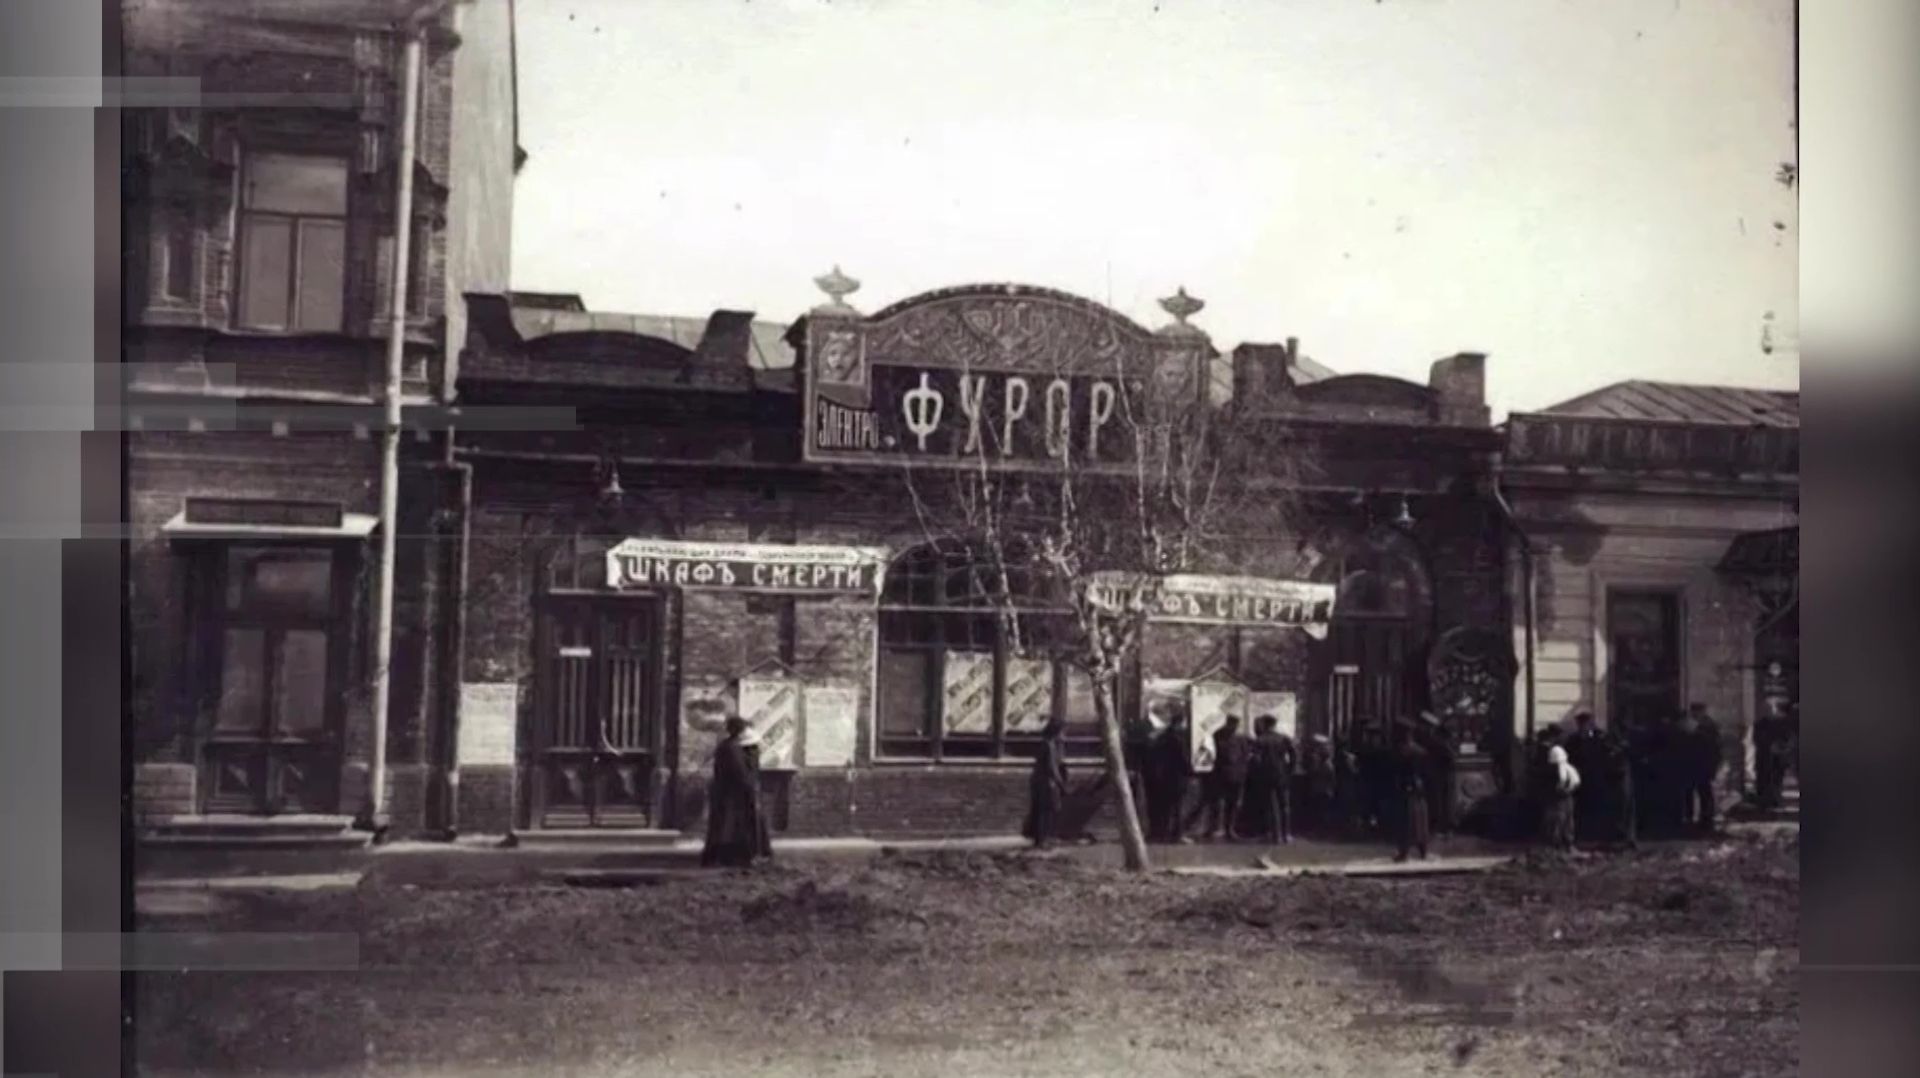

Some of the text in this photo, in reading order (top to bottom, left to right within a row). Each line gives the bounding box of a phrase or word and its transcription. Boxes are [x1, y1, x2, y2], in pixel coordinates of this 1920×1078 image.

[903, 371, 1115, 459] ФУРОР
[628, 557, 862, 588] ШКАФЪ СМЕРТИ
[1104, 588, 1314, 621] ШФЪ СМЕРТИ
